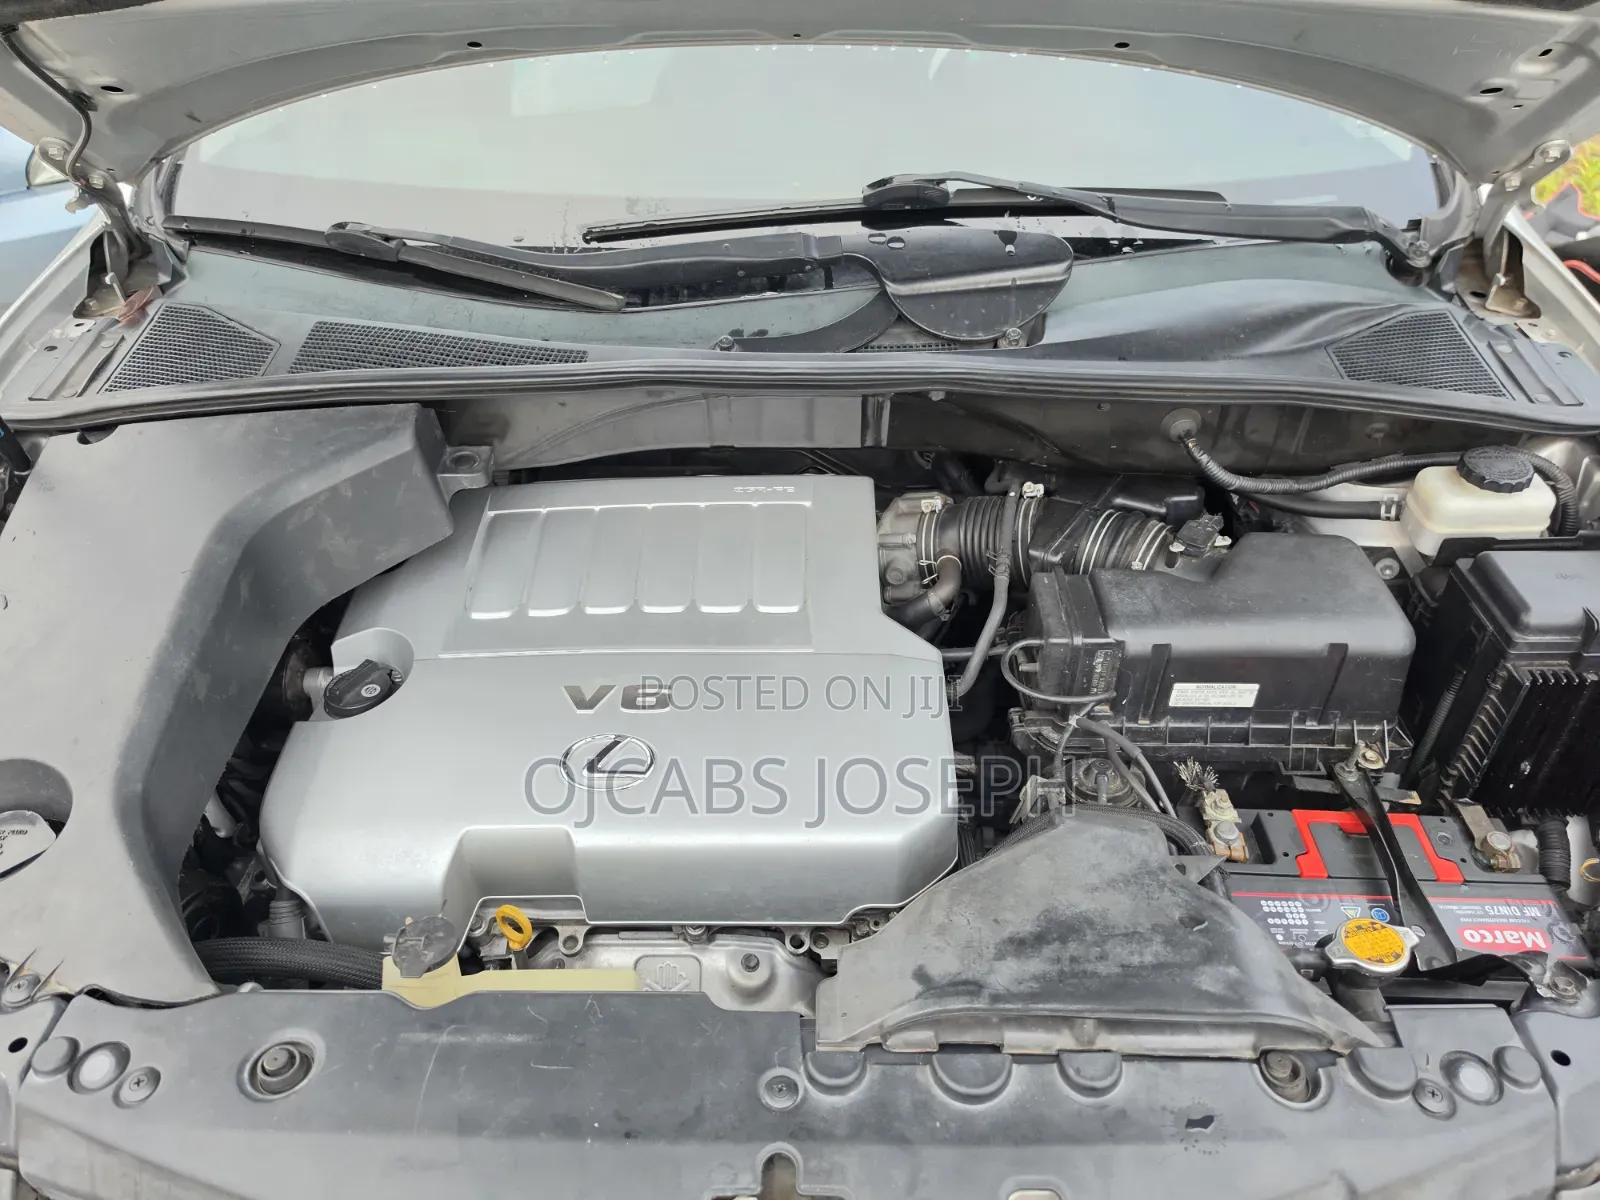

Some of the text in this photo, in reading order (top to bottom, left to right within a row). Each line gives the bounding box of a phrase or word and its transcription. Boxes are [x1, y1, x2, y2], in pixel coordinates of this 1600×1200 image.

[563, 684, 673, 713] V6
[1485, 905, 1521, 916] DIN75
[1522, 906, 1541, 917] MF
[1463, 929, 1547, 948] Marco
